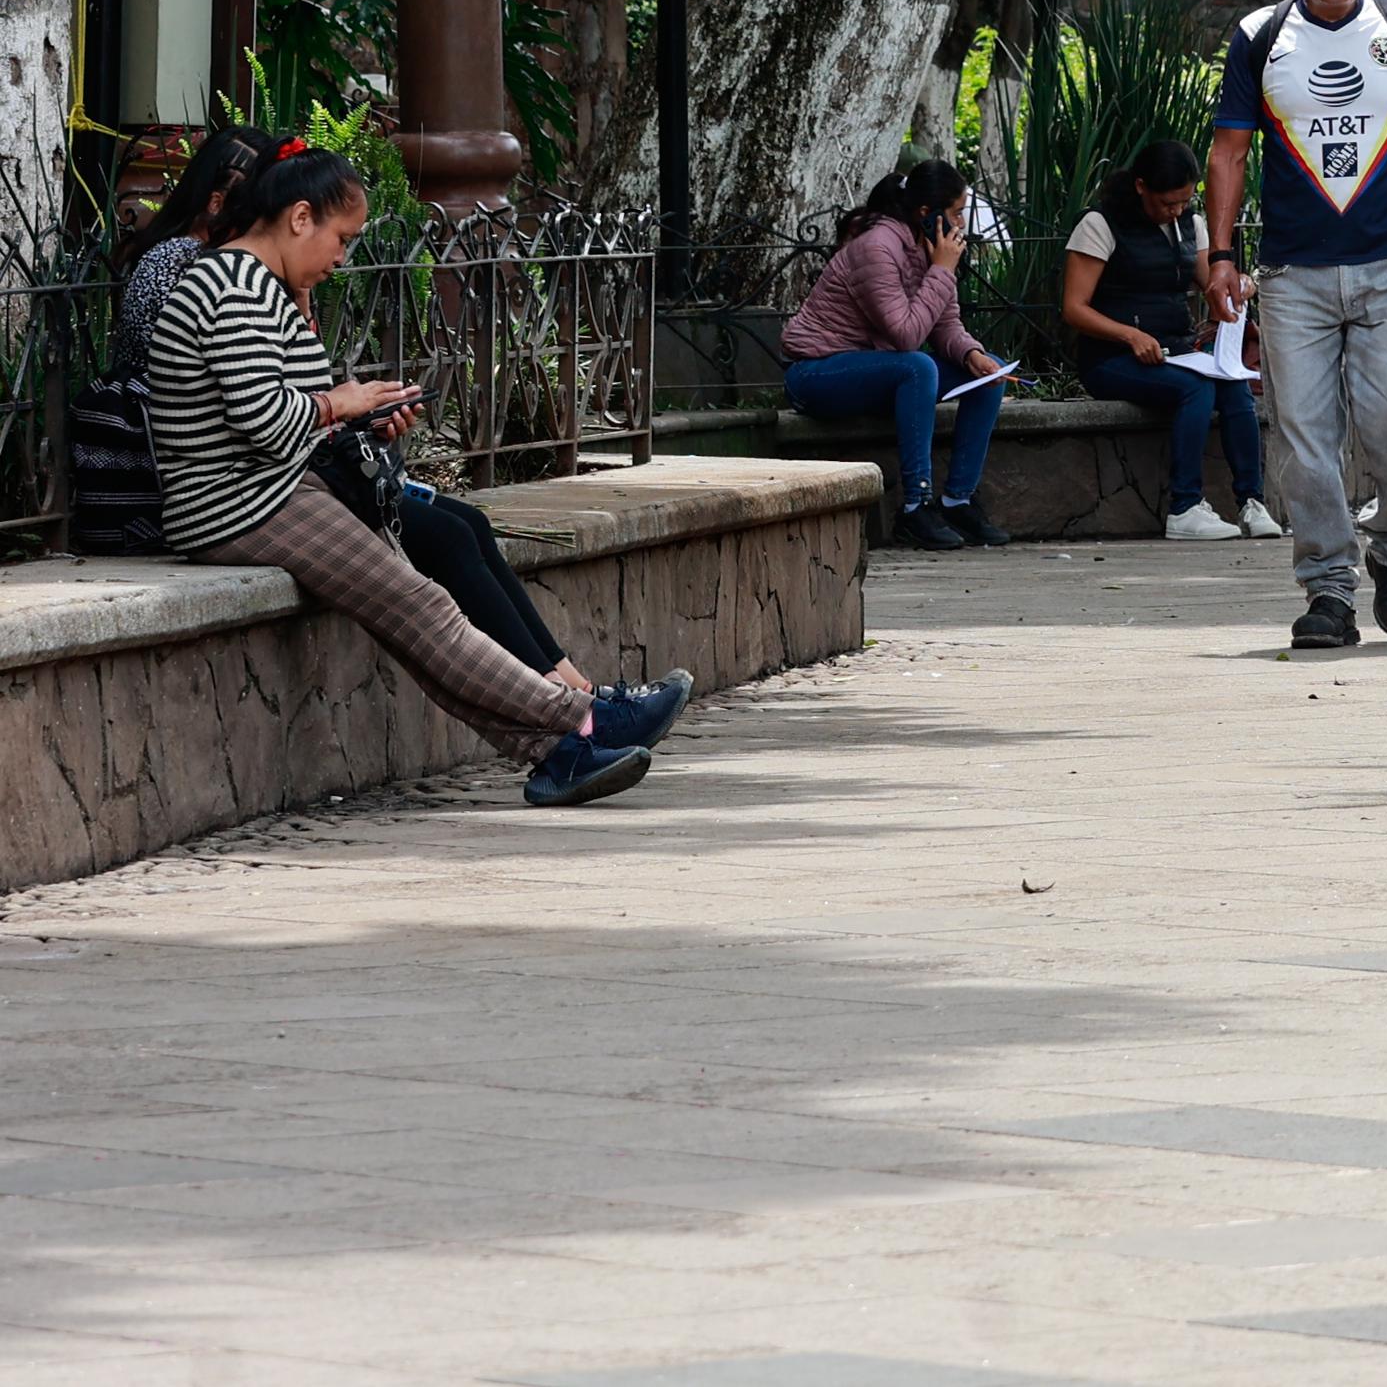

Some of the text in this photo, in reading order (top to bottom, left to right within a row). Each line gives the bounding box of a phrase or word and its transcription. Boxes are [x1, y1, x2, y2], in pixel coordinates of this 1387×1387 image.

[1308, 115, 1371, 138] AT&T
[1324, 142, 1358, 178] HOME
[1338, 155, 1358, 177] DEPOT
